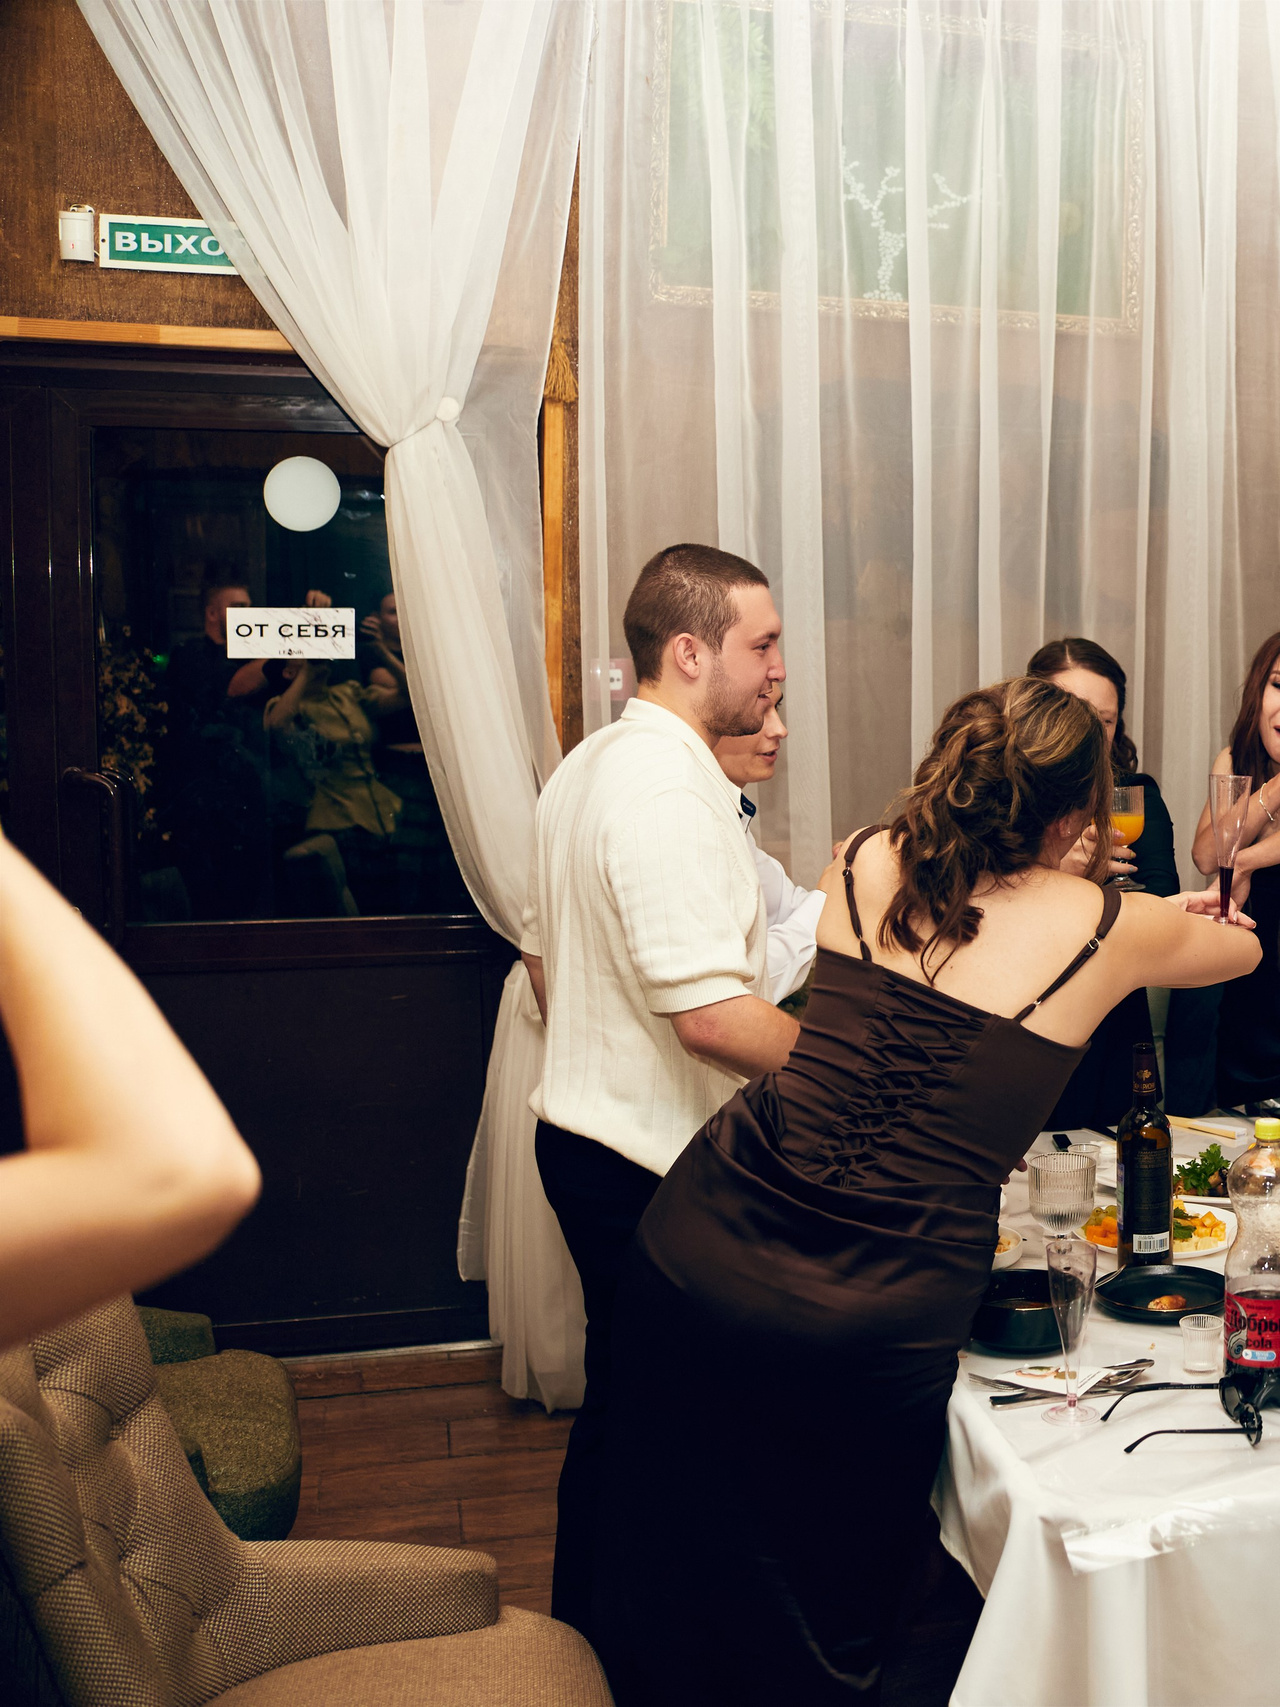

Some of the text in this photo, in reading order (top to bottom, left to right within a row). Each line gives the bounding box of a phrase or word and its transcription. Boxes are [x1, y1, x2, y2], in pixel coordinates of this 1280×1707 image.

[115, 231, 225, 256] ВЫХО
[235, 624, 346, 638] ОТ СЕБЯ
[1246, 1337, 1272, 1349] cola
